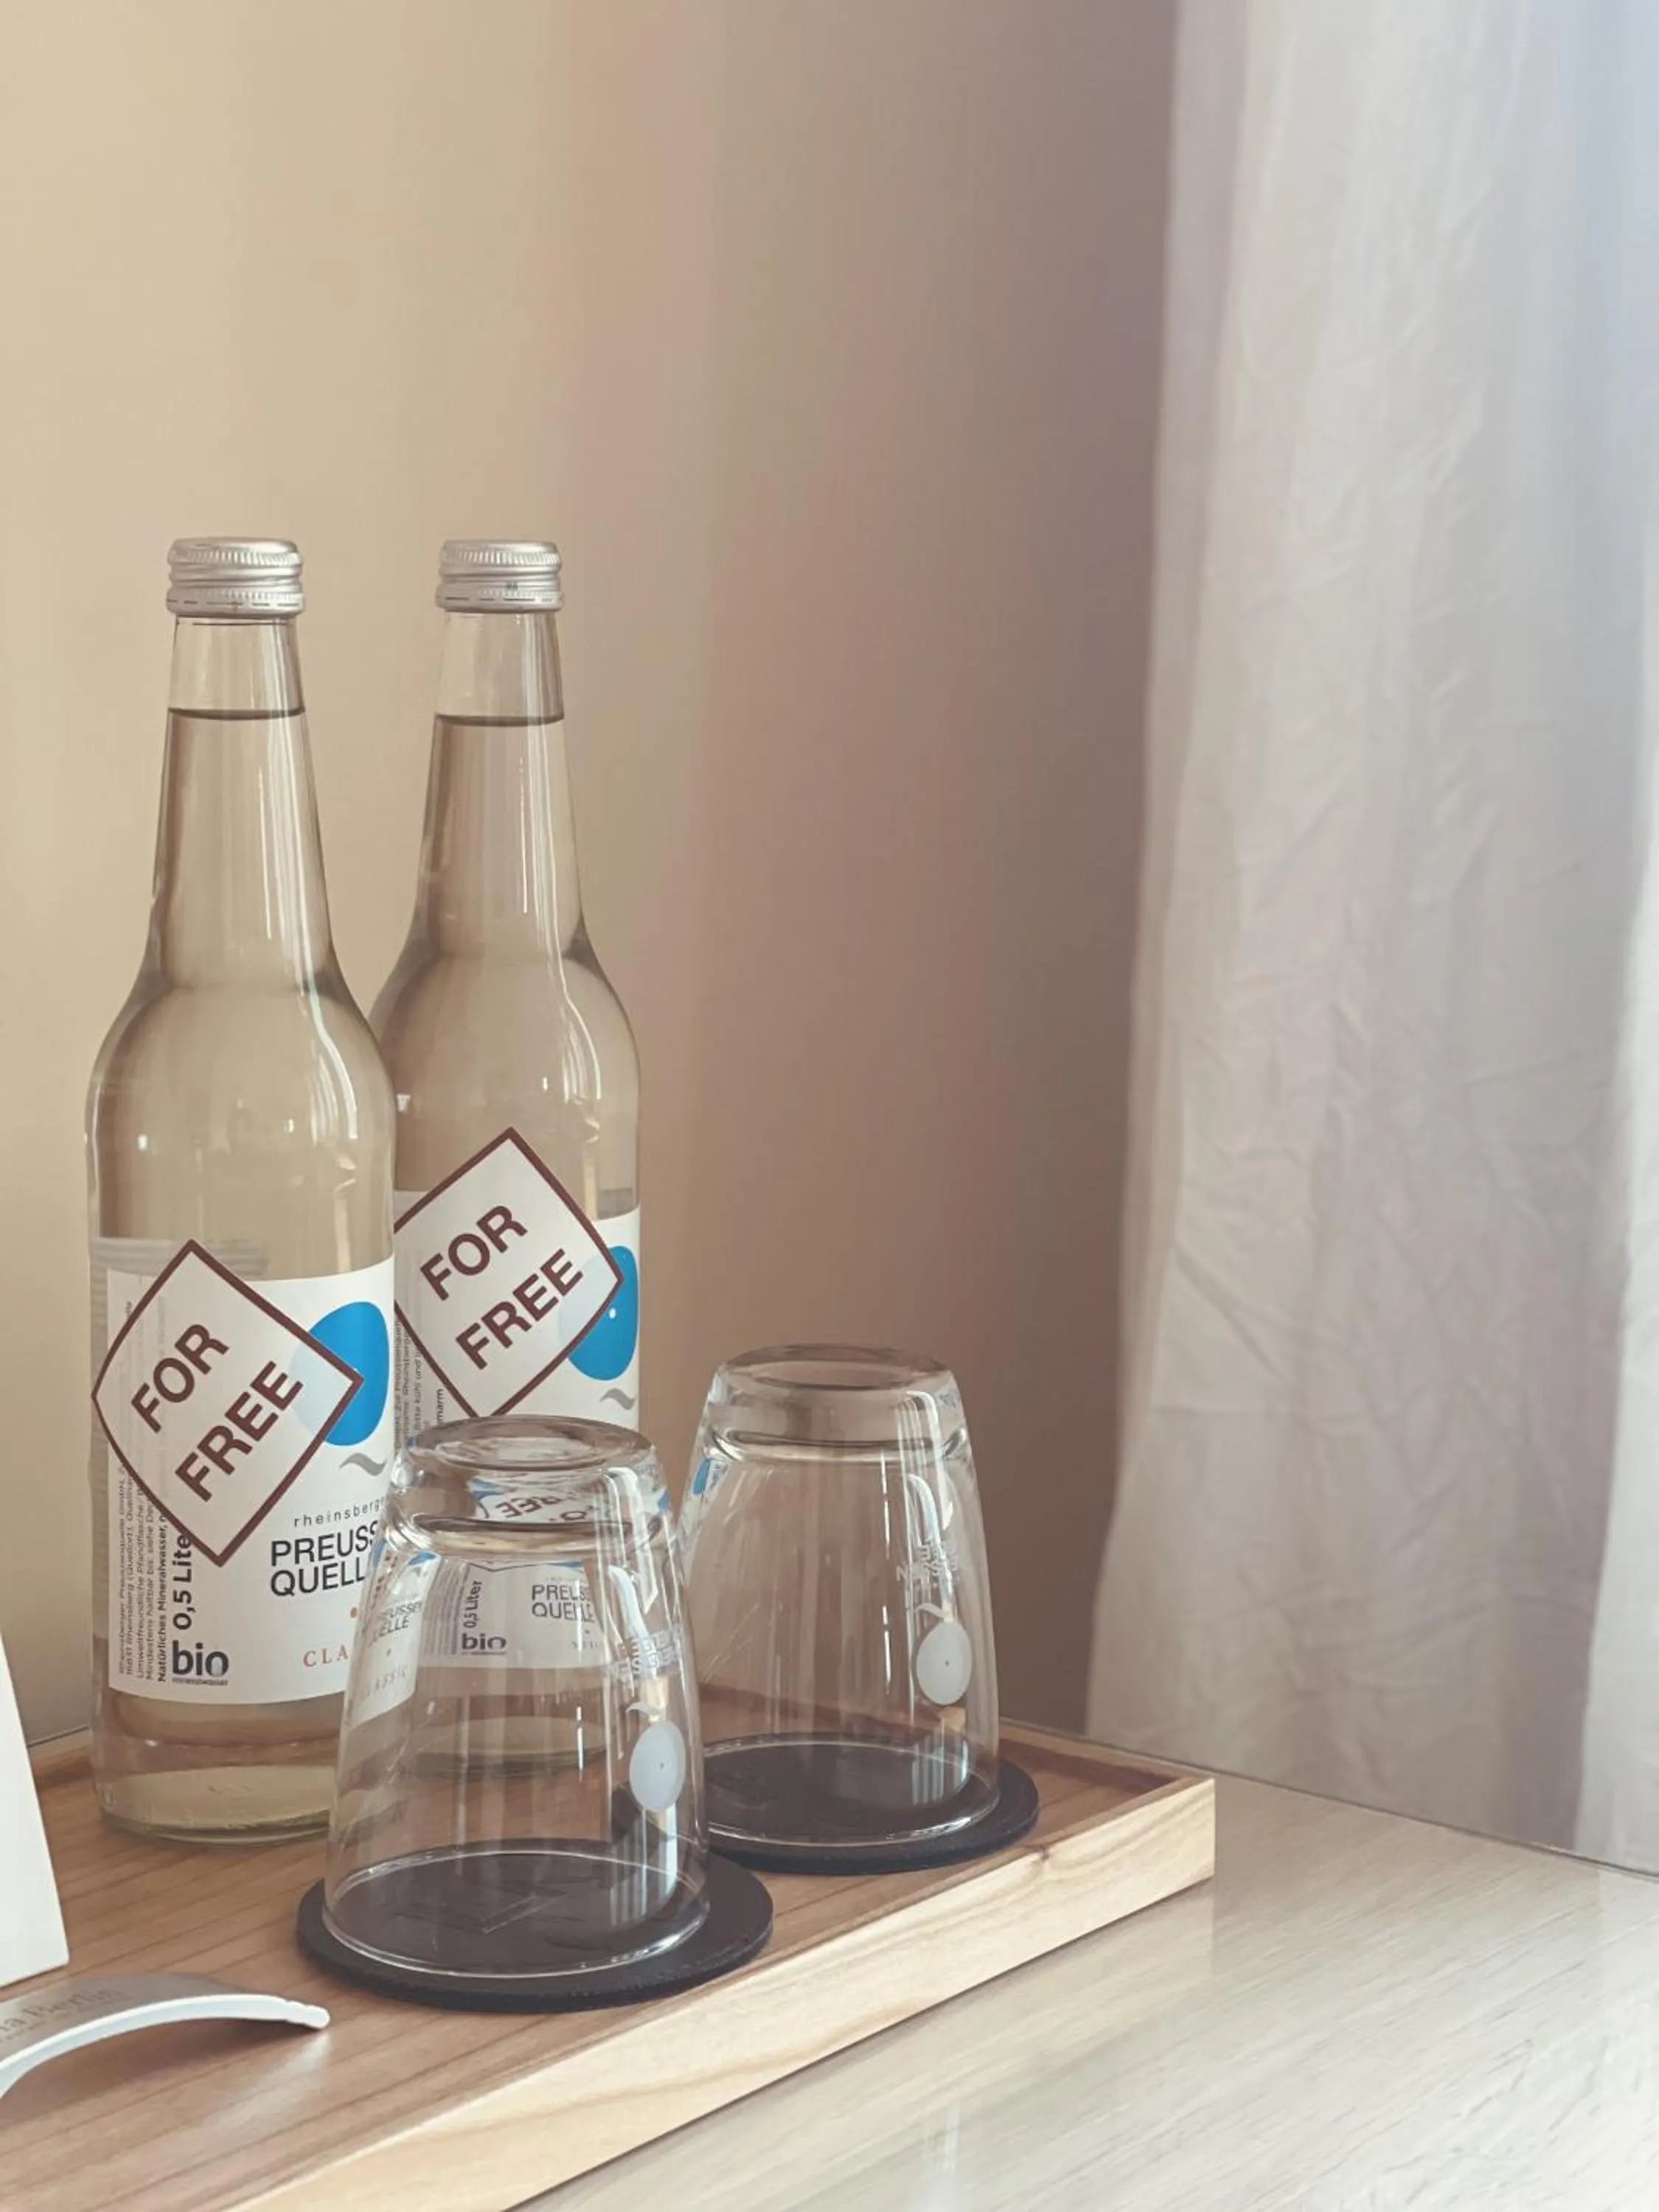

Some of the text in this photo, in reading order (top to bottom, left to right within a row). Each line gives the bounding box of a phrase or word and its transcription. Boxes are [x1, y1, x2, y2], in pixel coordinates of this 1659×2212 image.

[420, 1205, 529, 1301] FOR
[455, 1248, 583, 1370] FREE
[131, 1323, 229, 1433] FOR
[174, 1360, 303, 1502] FREE
[293, 1496, 386, 1528] rheinsberge
[159, 1523, 168, 1612] Mineralwasser,
[271, 1520, 378, 1567] PREUSS
[171, 1532, 195, 1631] 0,5 Lite
[271, 1557, 366, 1597] QUELL
[465, 1580, 483, 1612] Liter
[159, 1614, 167, 1683] Natürliches
[172, 1639, 230, 1677] bio
[302, 1644, 349, 1668] CLA
[461, 1632, 507, 1651] bio
